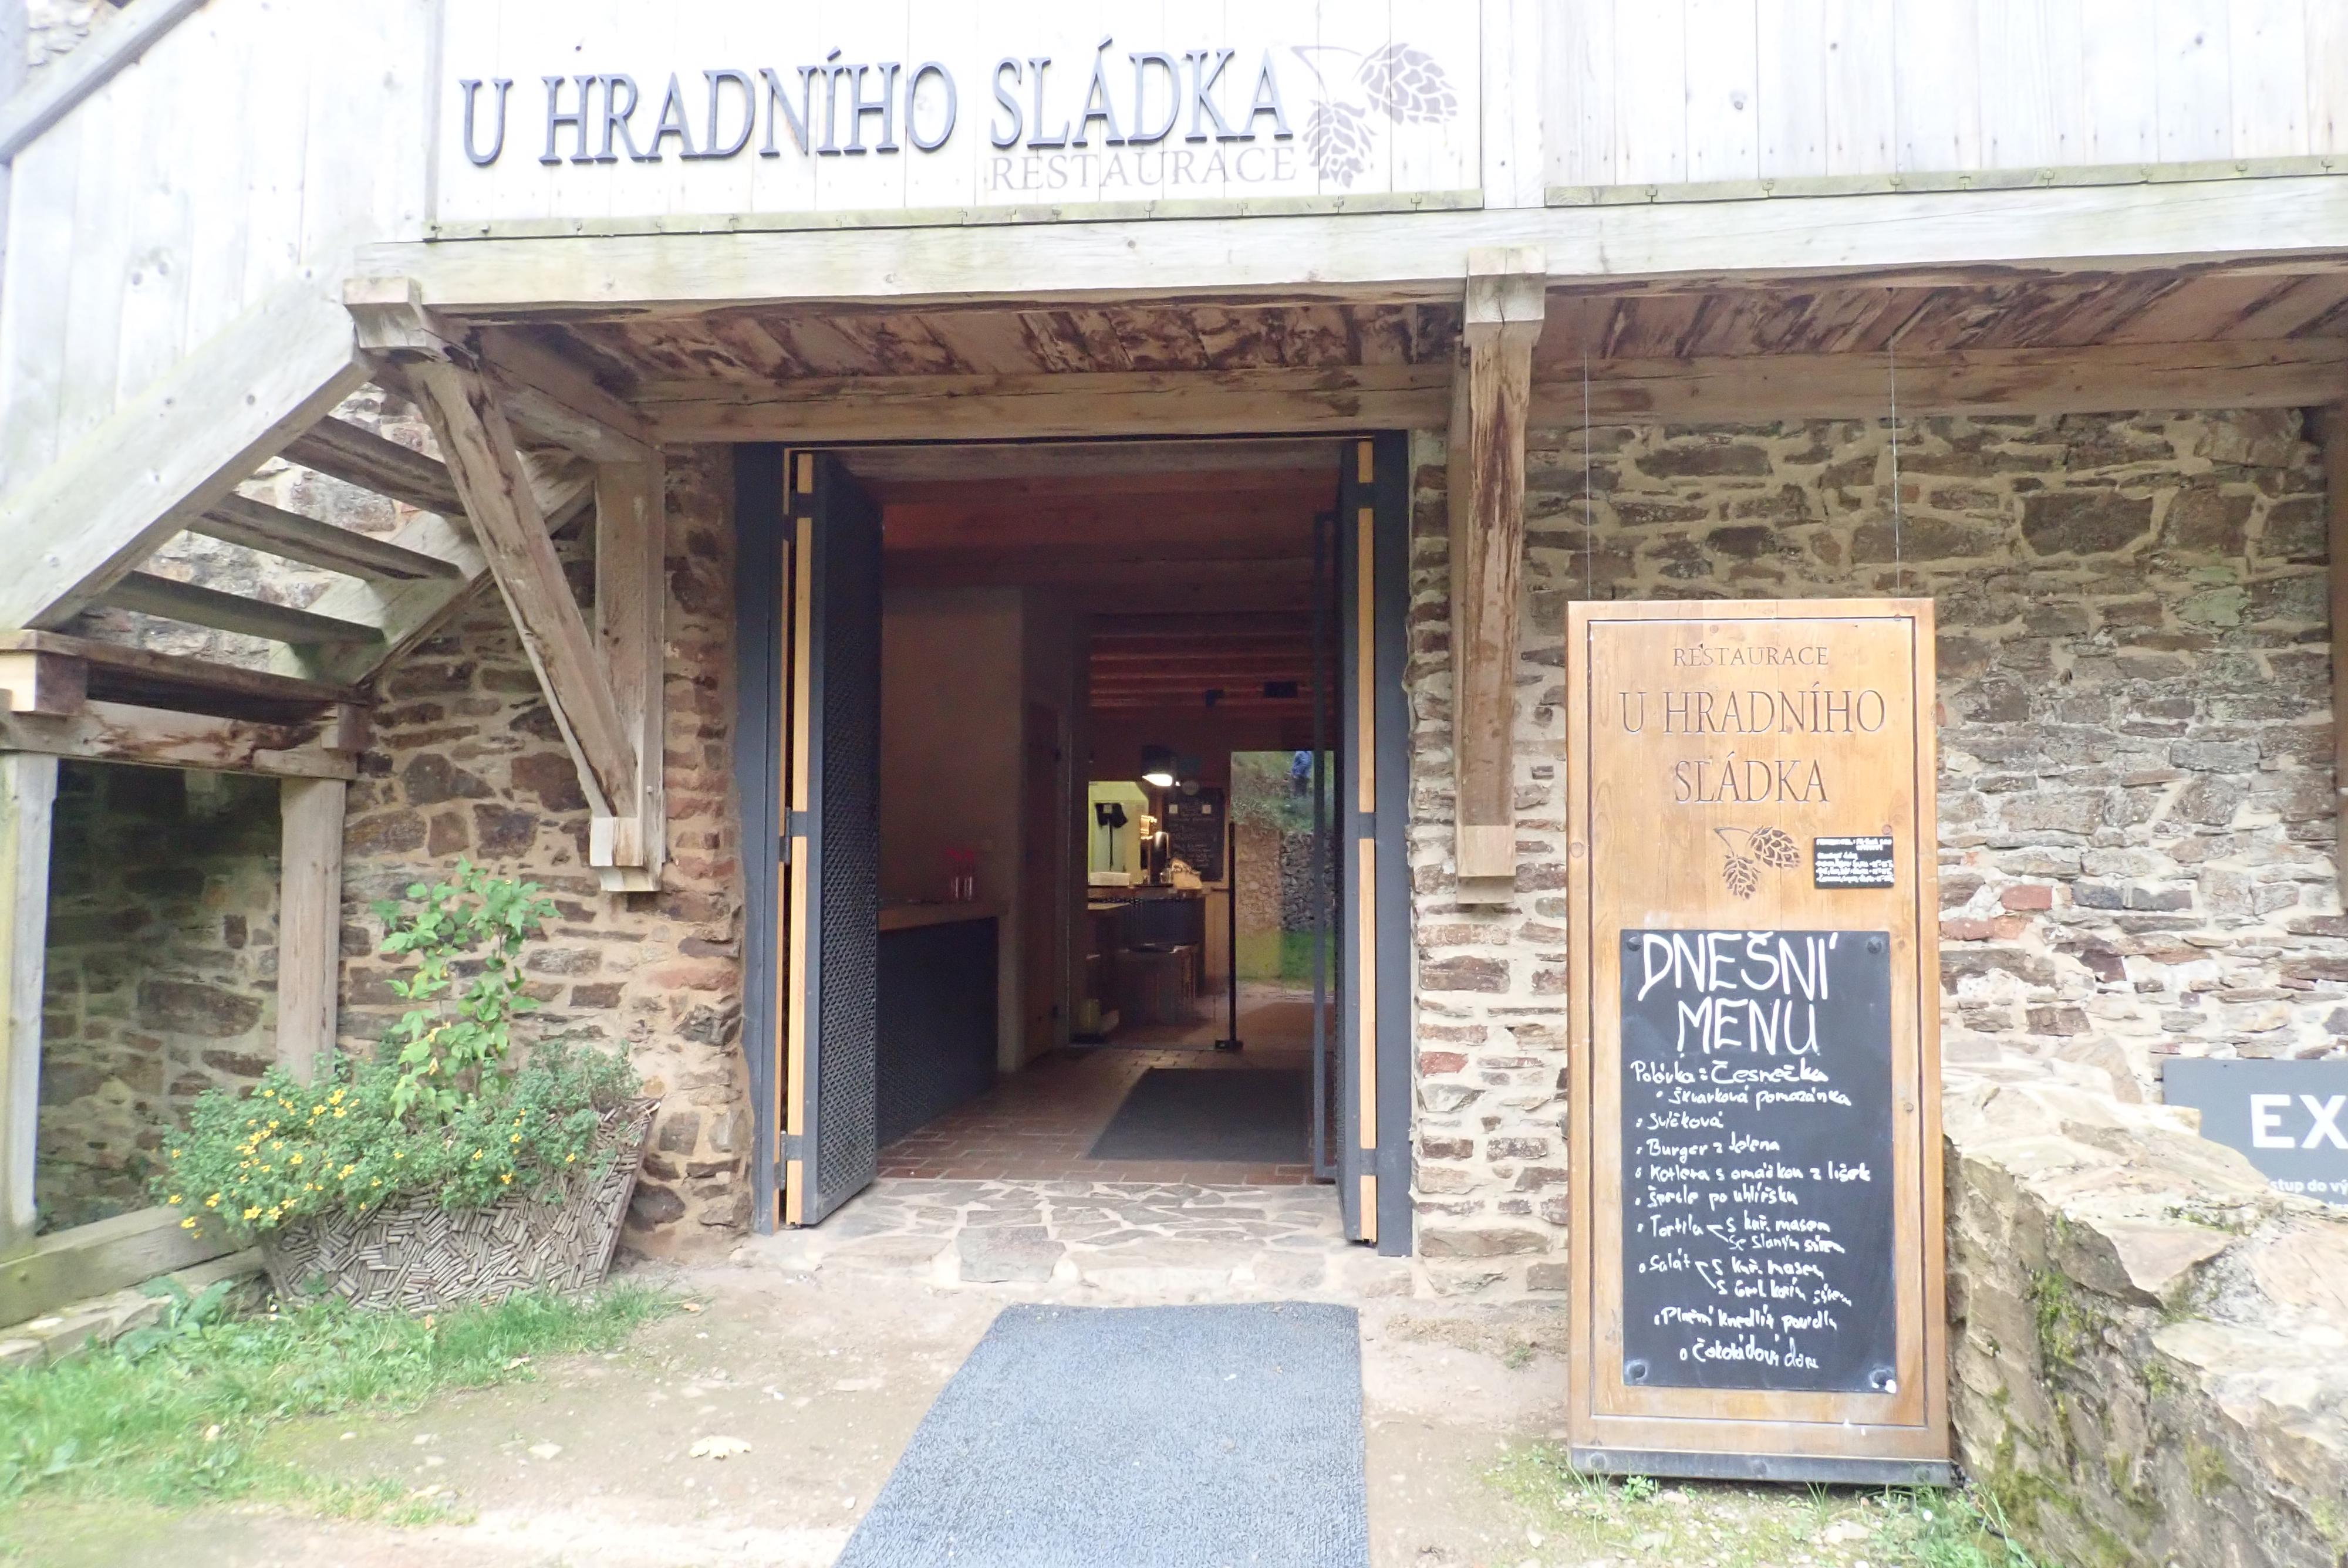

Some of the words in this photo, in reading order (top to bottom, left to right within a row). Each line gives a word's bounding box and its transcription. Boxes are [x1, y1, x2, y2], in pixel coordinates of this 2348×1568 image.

[459, 78, 513, 167] U
[539, 48, 959, 165] HRADNÍHO
[990, 35, 1294, 148] SLÁDKA
[990, 145, 1296, 191] RESTAURACE
[1673, 646, 1829, 667] RESTAURACE
[1619, 691, 1646, 734] U
[1662, 681, 1885, 734] HRADNÍHO
[1674, 751, 1830, 803] SLÁDKA
[1638, 931, 1838, 1001] DNEŠNÍ
[1676, 996, 1821, 1056] MENU
[1646, 1138, 1708, 1164] Burger
[2269, 1179, 2305, 1193] stup
[2307, 1180, 2327, 1192] do
